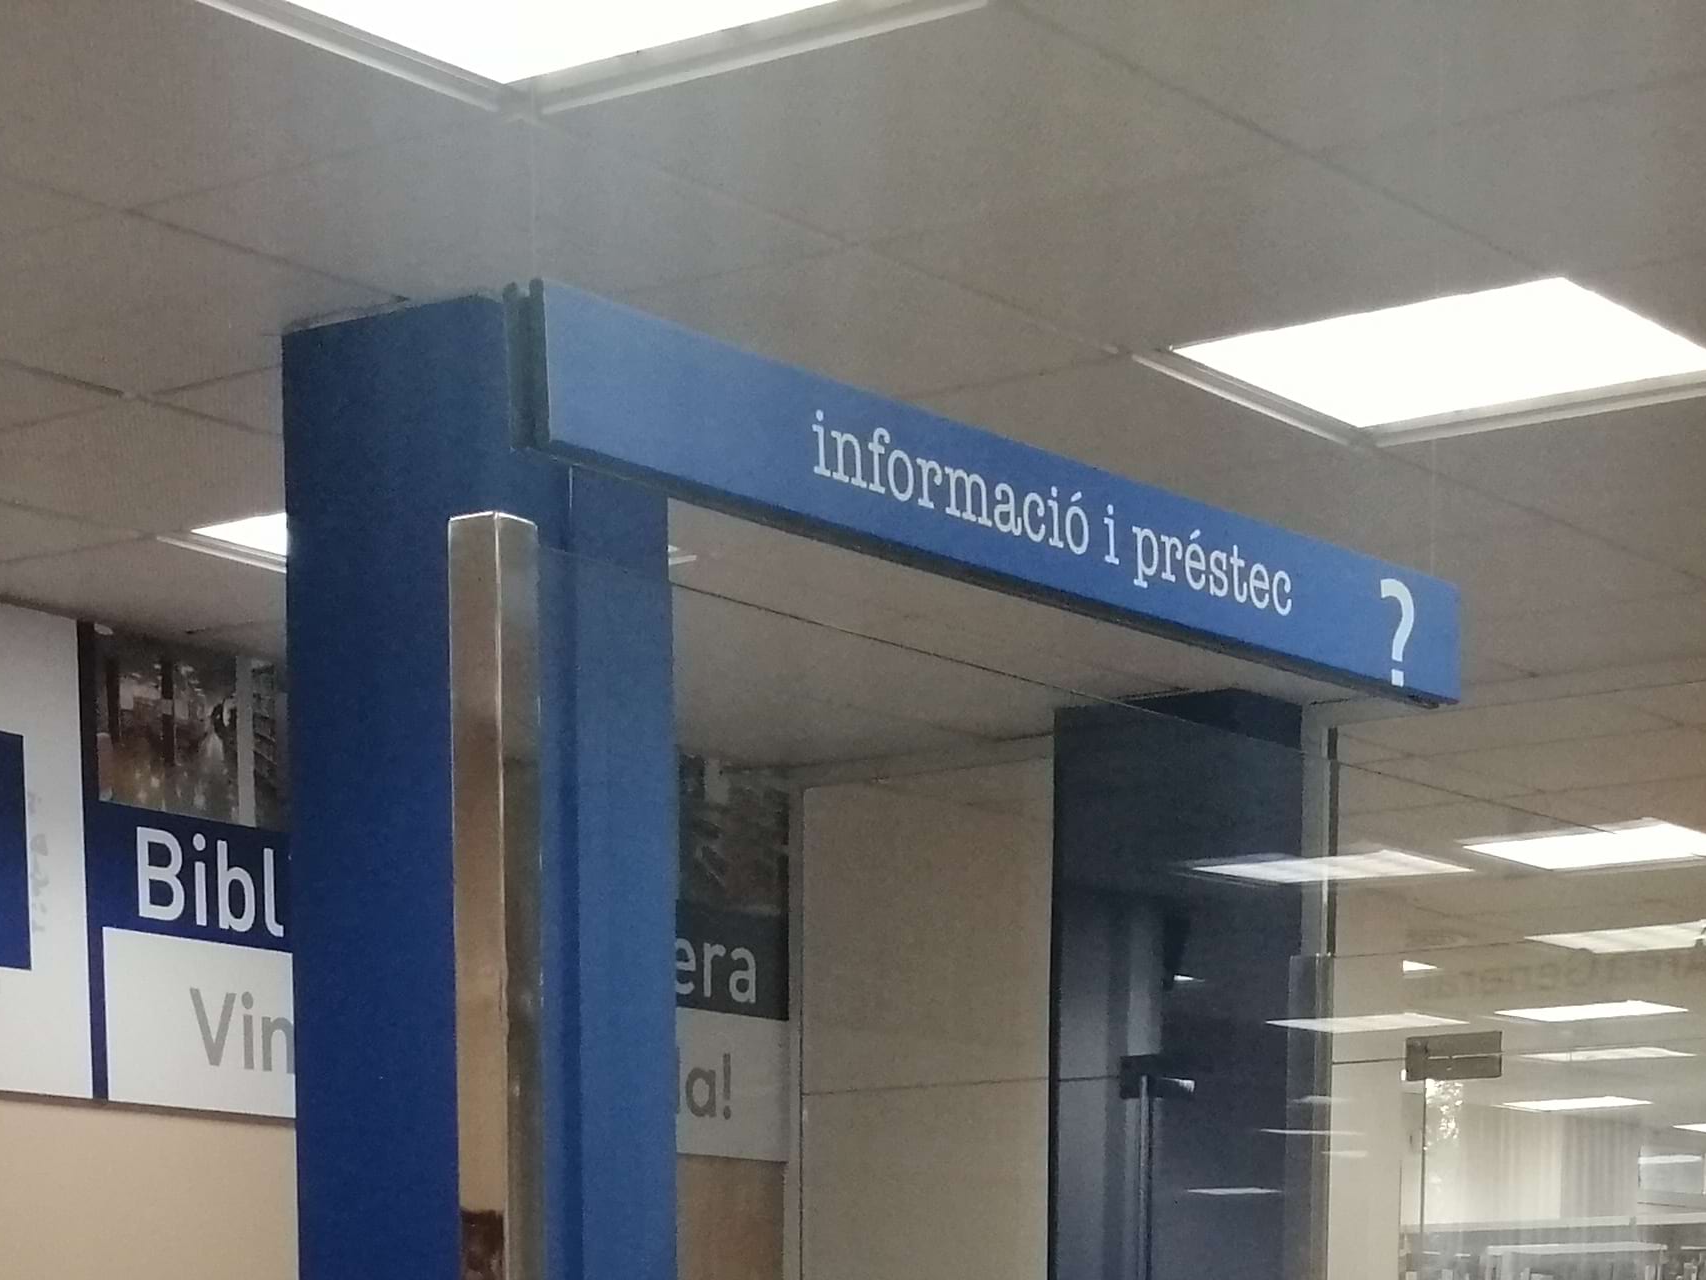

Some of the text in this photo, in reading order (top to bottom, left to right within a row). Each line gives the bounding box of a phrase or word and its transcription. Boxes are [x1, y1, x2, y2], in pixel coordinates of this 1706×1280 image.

[810, 409, 1089, 555] informació
[1104, 506, 1120, 567] i
[1131, 526, 1294, 620] préstec
